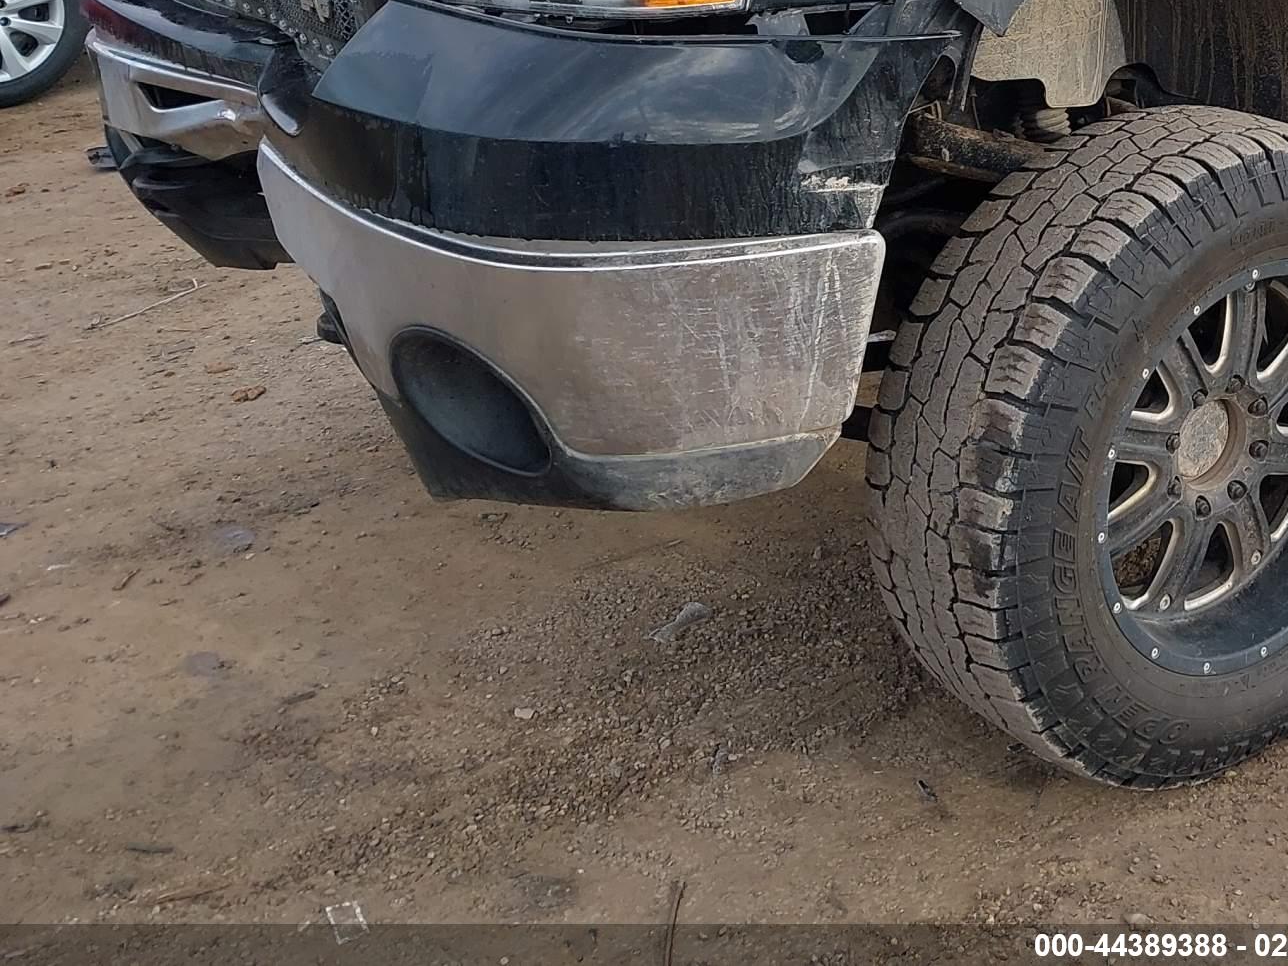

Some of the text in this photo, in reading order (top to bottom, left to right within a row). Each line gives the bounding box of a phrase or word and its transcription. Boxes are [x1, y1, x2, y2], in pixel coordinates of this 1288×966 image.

[1057, 426, 1091, 521] A/T
[1053, 529, 1107, 683] RANGE
[1093, 682, 1190, 744] OPEN
